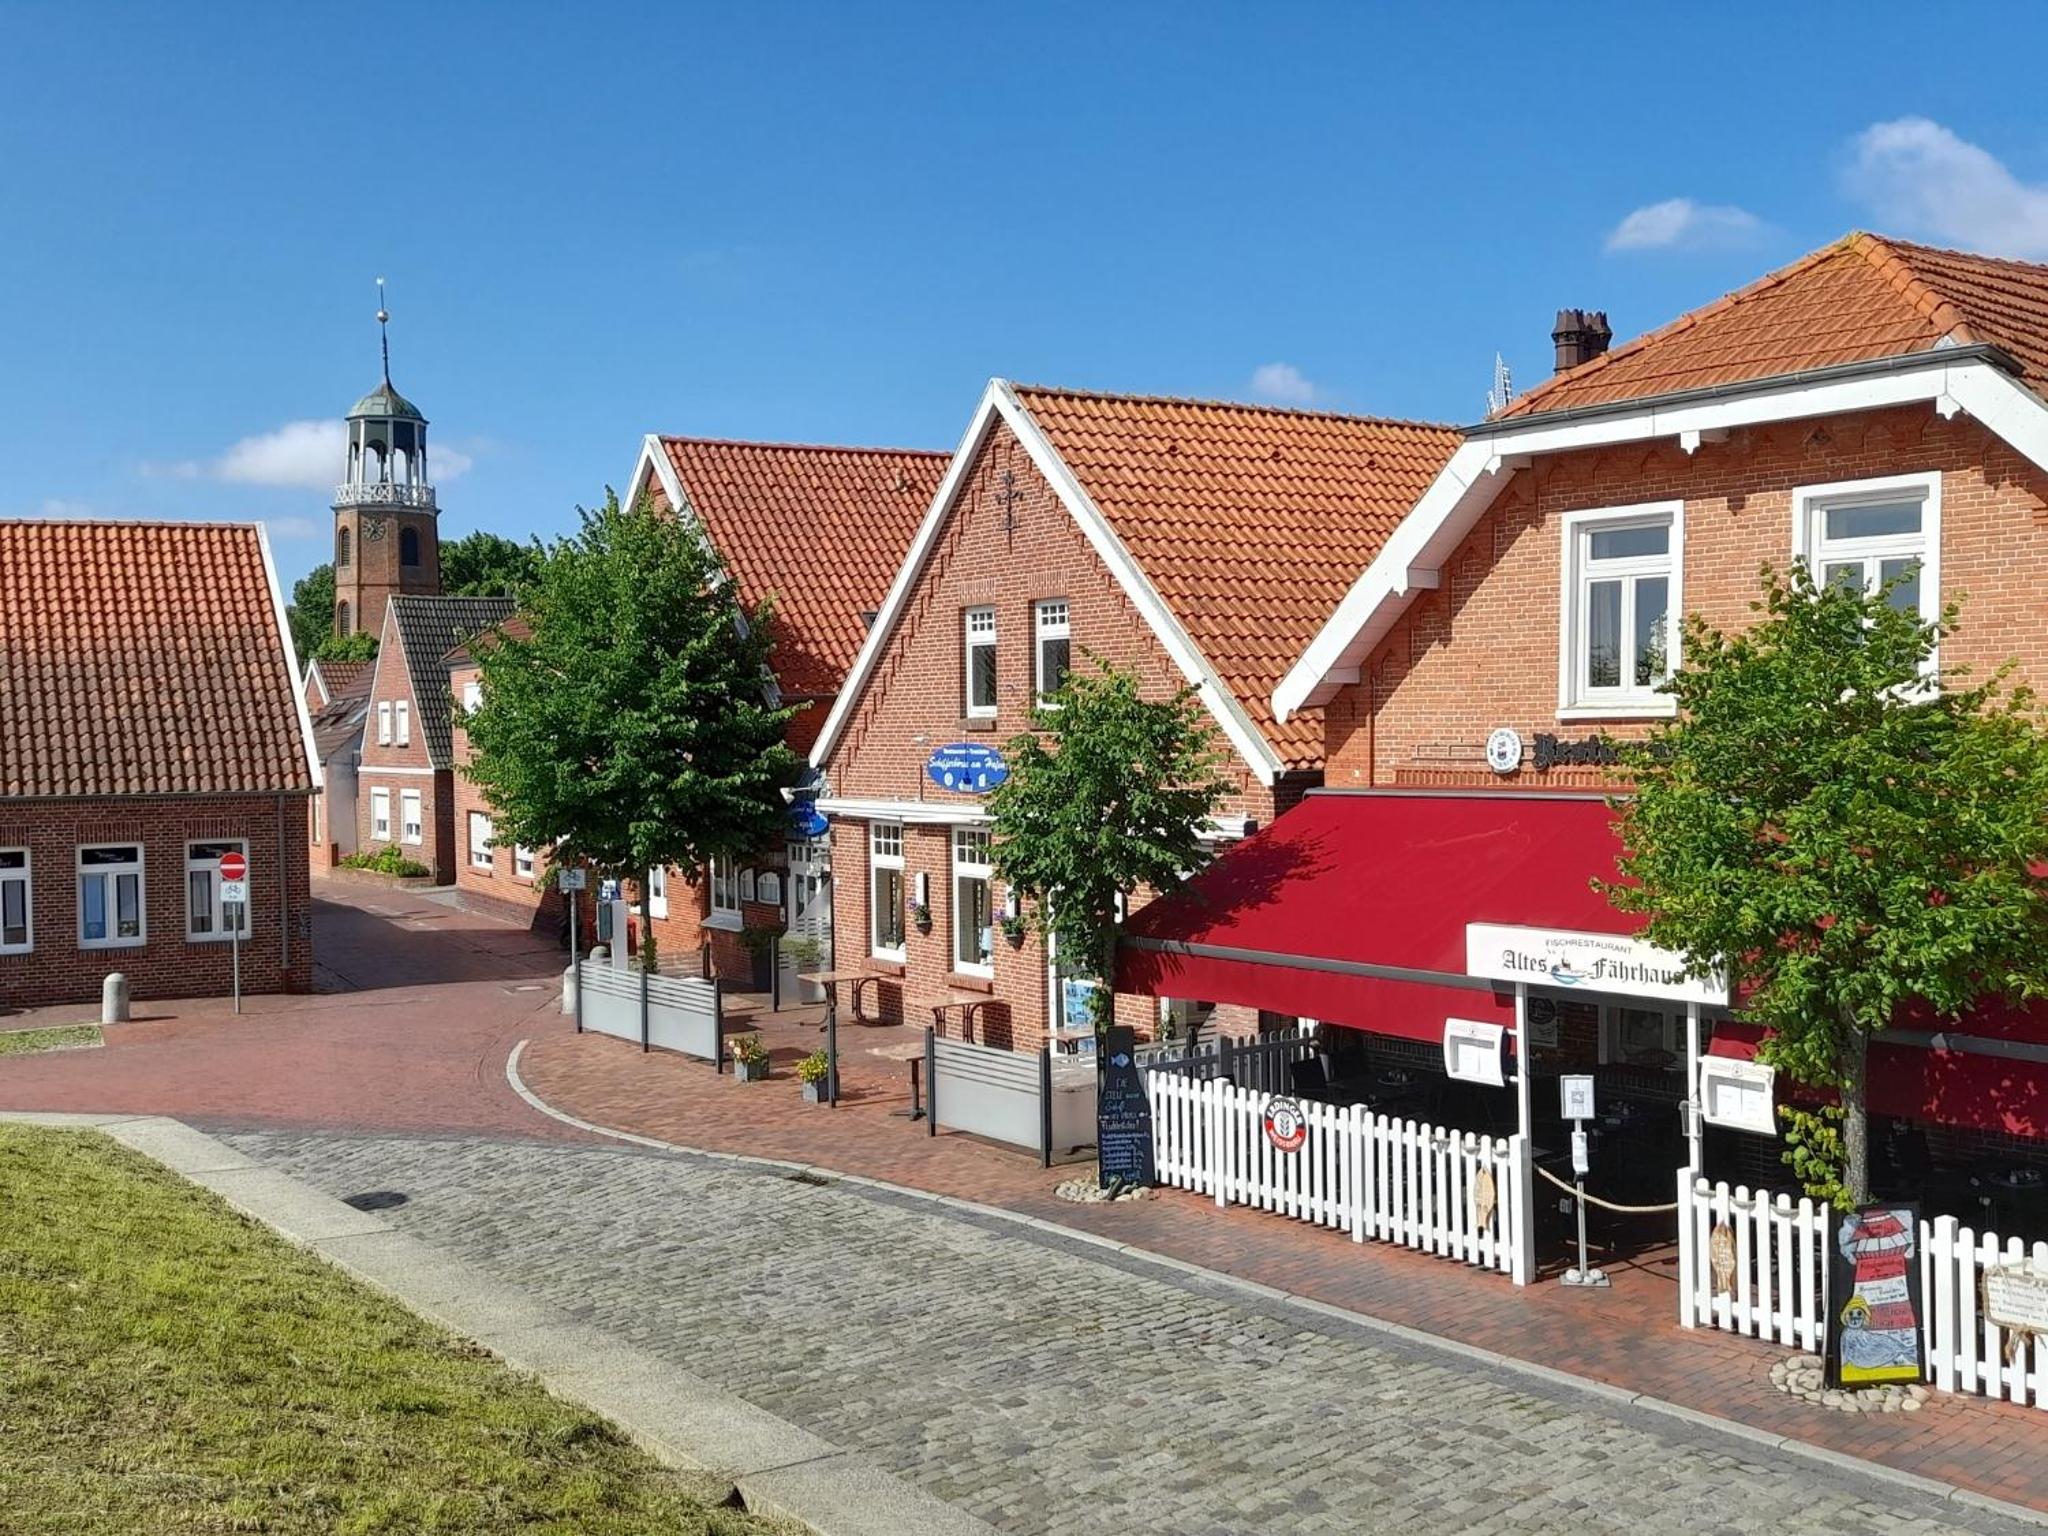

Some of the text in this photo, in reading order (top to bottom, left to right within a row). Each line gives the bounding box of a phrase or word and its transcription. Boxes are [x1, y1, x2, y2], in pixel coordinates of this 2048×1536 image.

[1545, 938, 1632, 954] FISCHRESTAURANT
[1502, 949, 1548, 973] Altes
[1266, 1101, 1303, 1125] ERDINGER
